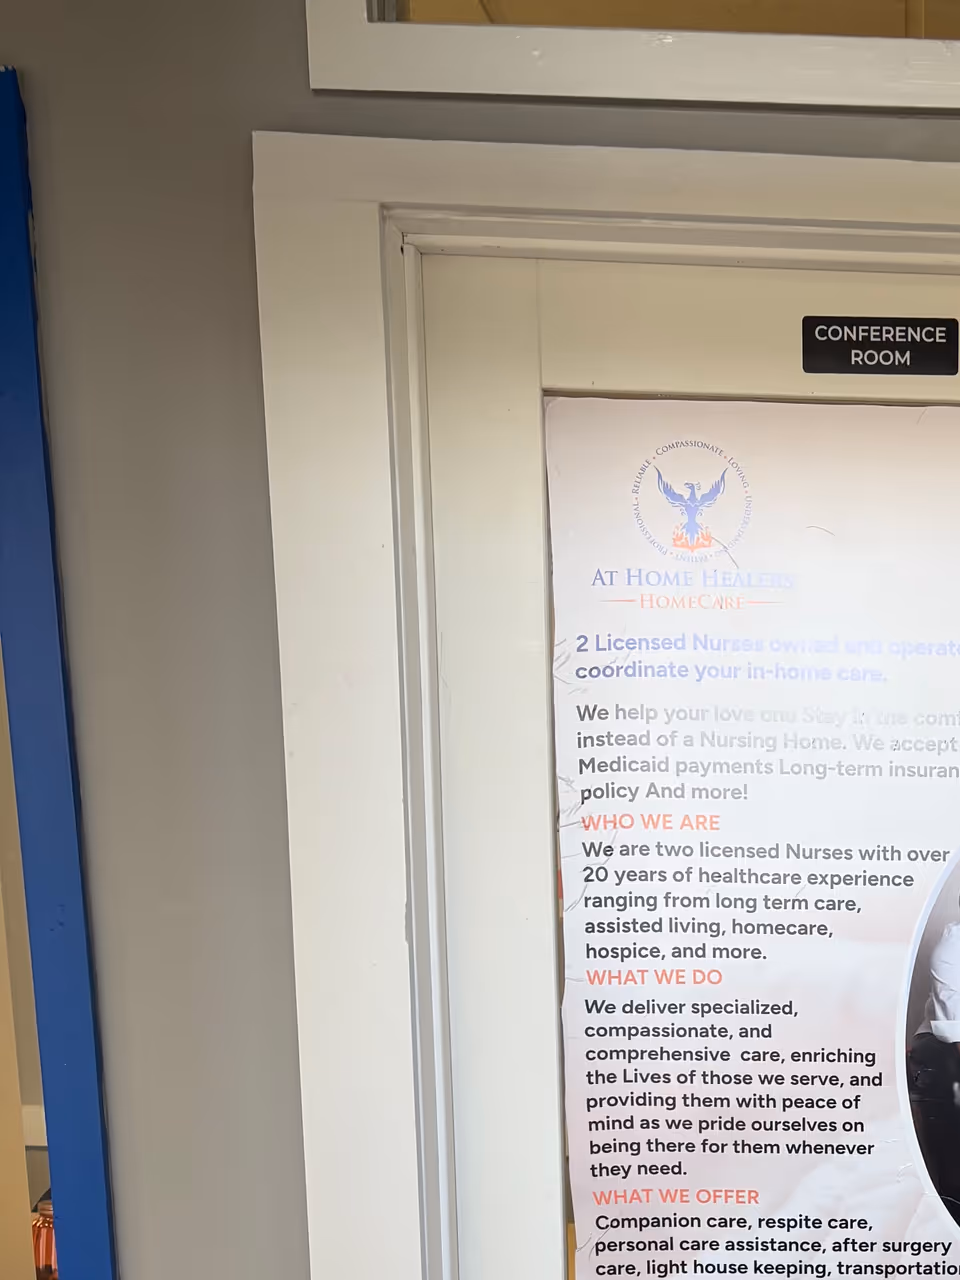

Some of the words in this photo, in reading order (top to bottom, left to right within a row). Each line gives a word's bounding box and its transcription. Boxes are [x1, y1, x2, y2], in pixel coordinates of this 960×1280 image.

[814, 325, 947, 343] CONFERENCE
[851, 350, 911, 366] ROOM
[655, 440, 725, 457] COMPASSIONATE
[632, 459, 652, 495] RELIABLE
[727, 457, 750, 489] LOVING
[575, 660, 689, 679] coordinate
[695, 664, 741, 683] your
[747, 662, 832, 682] in-home
[578, 754, 670, 776] Medicaid
[675, 758, 774, 778] payments
[779, 758, 883, 780] Long-term
[580, 781, 640, 806] policy
[645, 781, 685, 799] And
[691, 783, 748, 800] more!
[580, 813, 635, 832] WHO
[639, 813, 673, 830] WE
[679, 814, 721, 831] ARE
[582, 865, 609, 883] 20
[613, 869, 668, 887] years
[672, 866, 694, 883] of
[698, 866, 802, 885] healthcare
[806, 869, 915, 890] experience
[584, 916, 663, 934] assisted
[668, 916, 726, 938] living,
[732, 918, 833, 939] homecare,
[585, 941, 666, 963] hospice,
[671, 942, 706, 959] and
[712, 946, 767, 960] more.
[586, 969, 649, 986] WHAT
[653, 968, 686, 985] WE
[692, 969, 723, 985] DO
[584, 999, 617, 1014] We
[621, 998, 687, 1015] deliver
[691, 998, 798, 1018] specialized,
[584, 1022, 734, 1041] compassionate,
[738, 1023, 772, 1039] and
[585, 1046, 731, 1064] comprehensive
[740, 1050, 786, 1065] care,
[790, 1047, 876, 1068] enriching
[589, 1162, 632, 1180] they
[637, 1160, 688, 1176] need.
[592, 1188, 654, 1206] WHAT
[658, 1188, 690, 1204] WE
[695, 1188, 760, 1205] OFFER
[595, 1212, 702, 1232] Companion
[706, 1217, 753, 1231] care,
[758, 1213, 823, 1233] respite
[827, 1218, 873, 1232] care,
[594, 1236, 674, 1257] personal
[679, 1239, 720, 1251] care
[724, 1236, 827, 1255] assistance,
[831, 1237, 878, 1253] after
[882, 1241, 953, 1257] surgery
[595, 1263, 641, 1277] care,
[646, 1259, 688, 1279] light
[693, 1259, 749, 1275] house
[753, 1259, 832, 1279] keeping,
